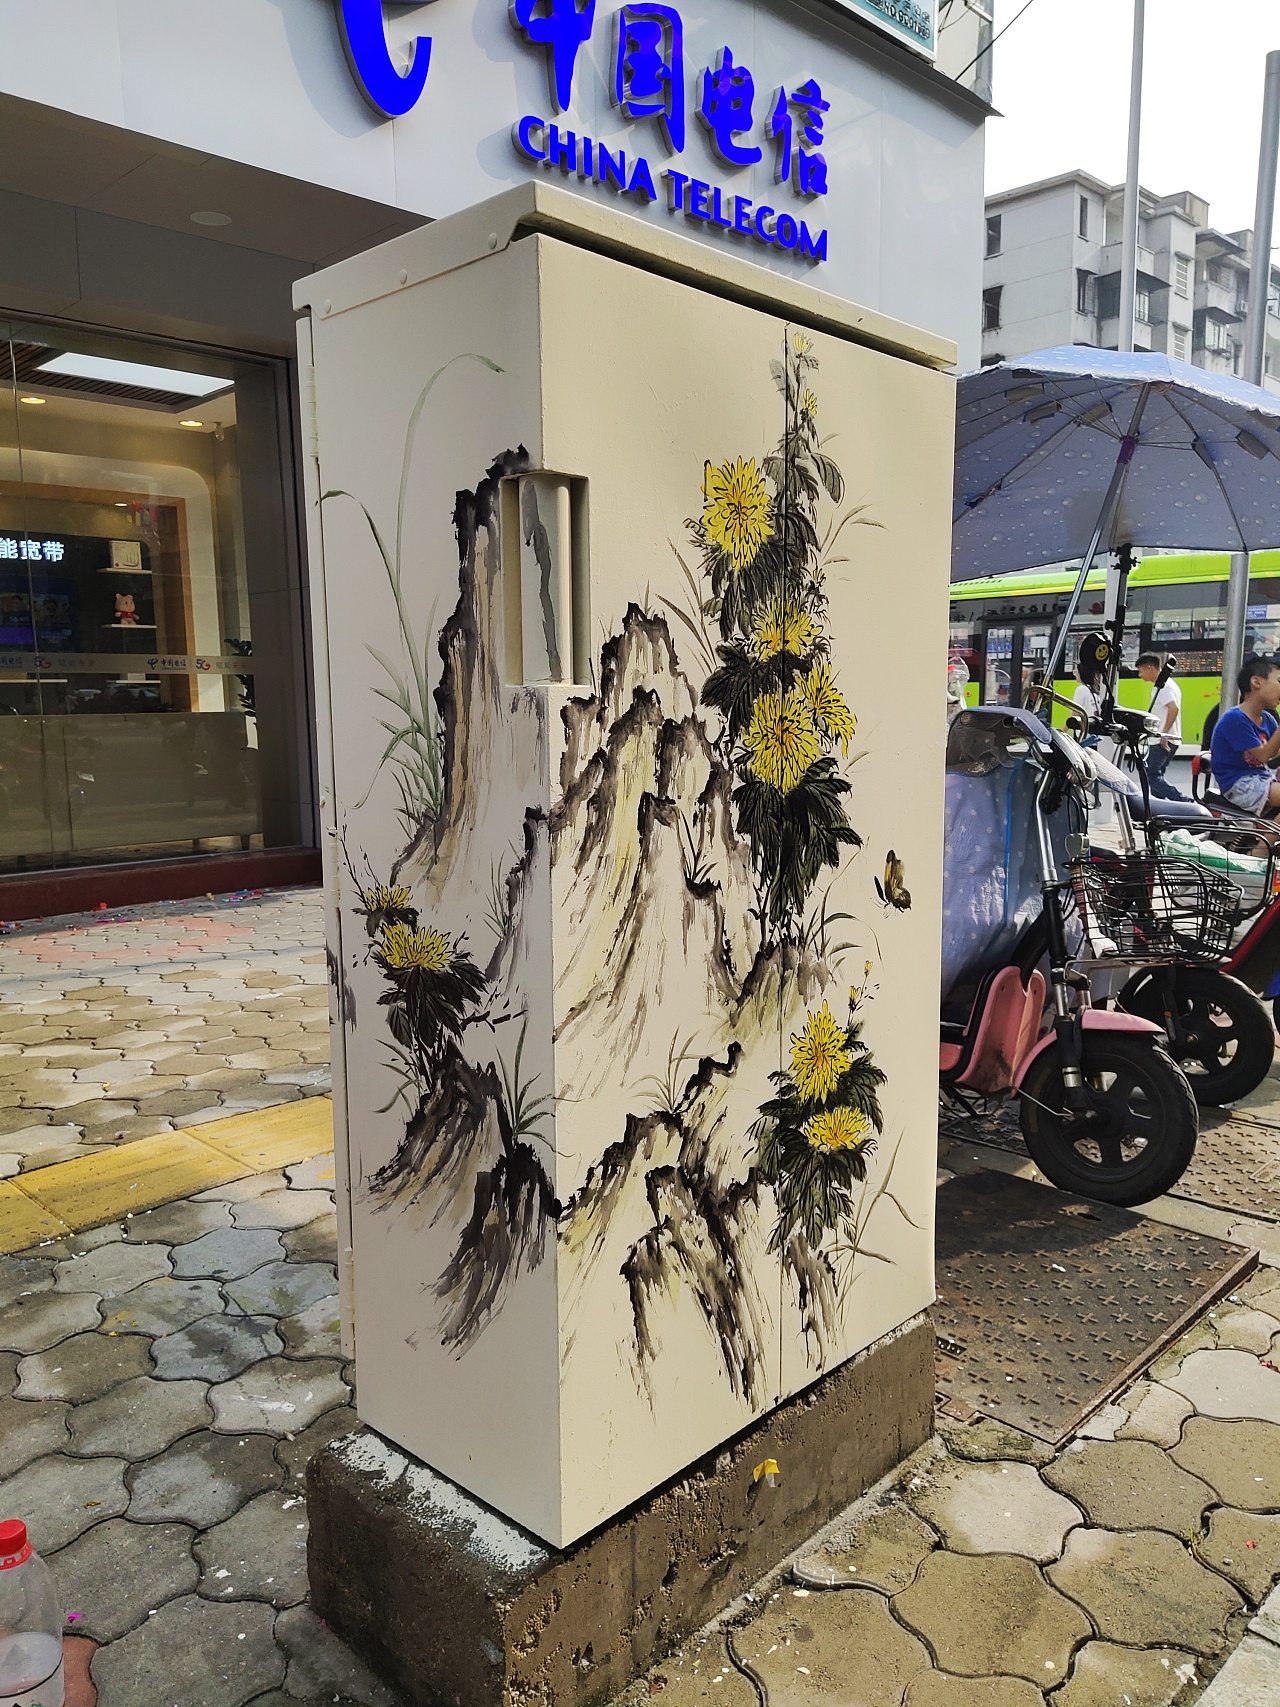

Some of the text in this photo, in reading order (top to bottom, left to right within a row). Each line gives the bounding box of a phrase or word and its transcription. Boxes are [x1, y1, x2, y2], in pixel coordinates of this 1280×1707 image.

[514, 0, 831, 196] 中国电信
[517, 116, 828, 260] CHINA TELECOM
[196, 659, 211, 671] 5G
